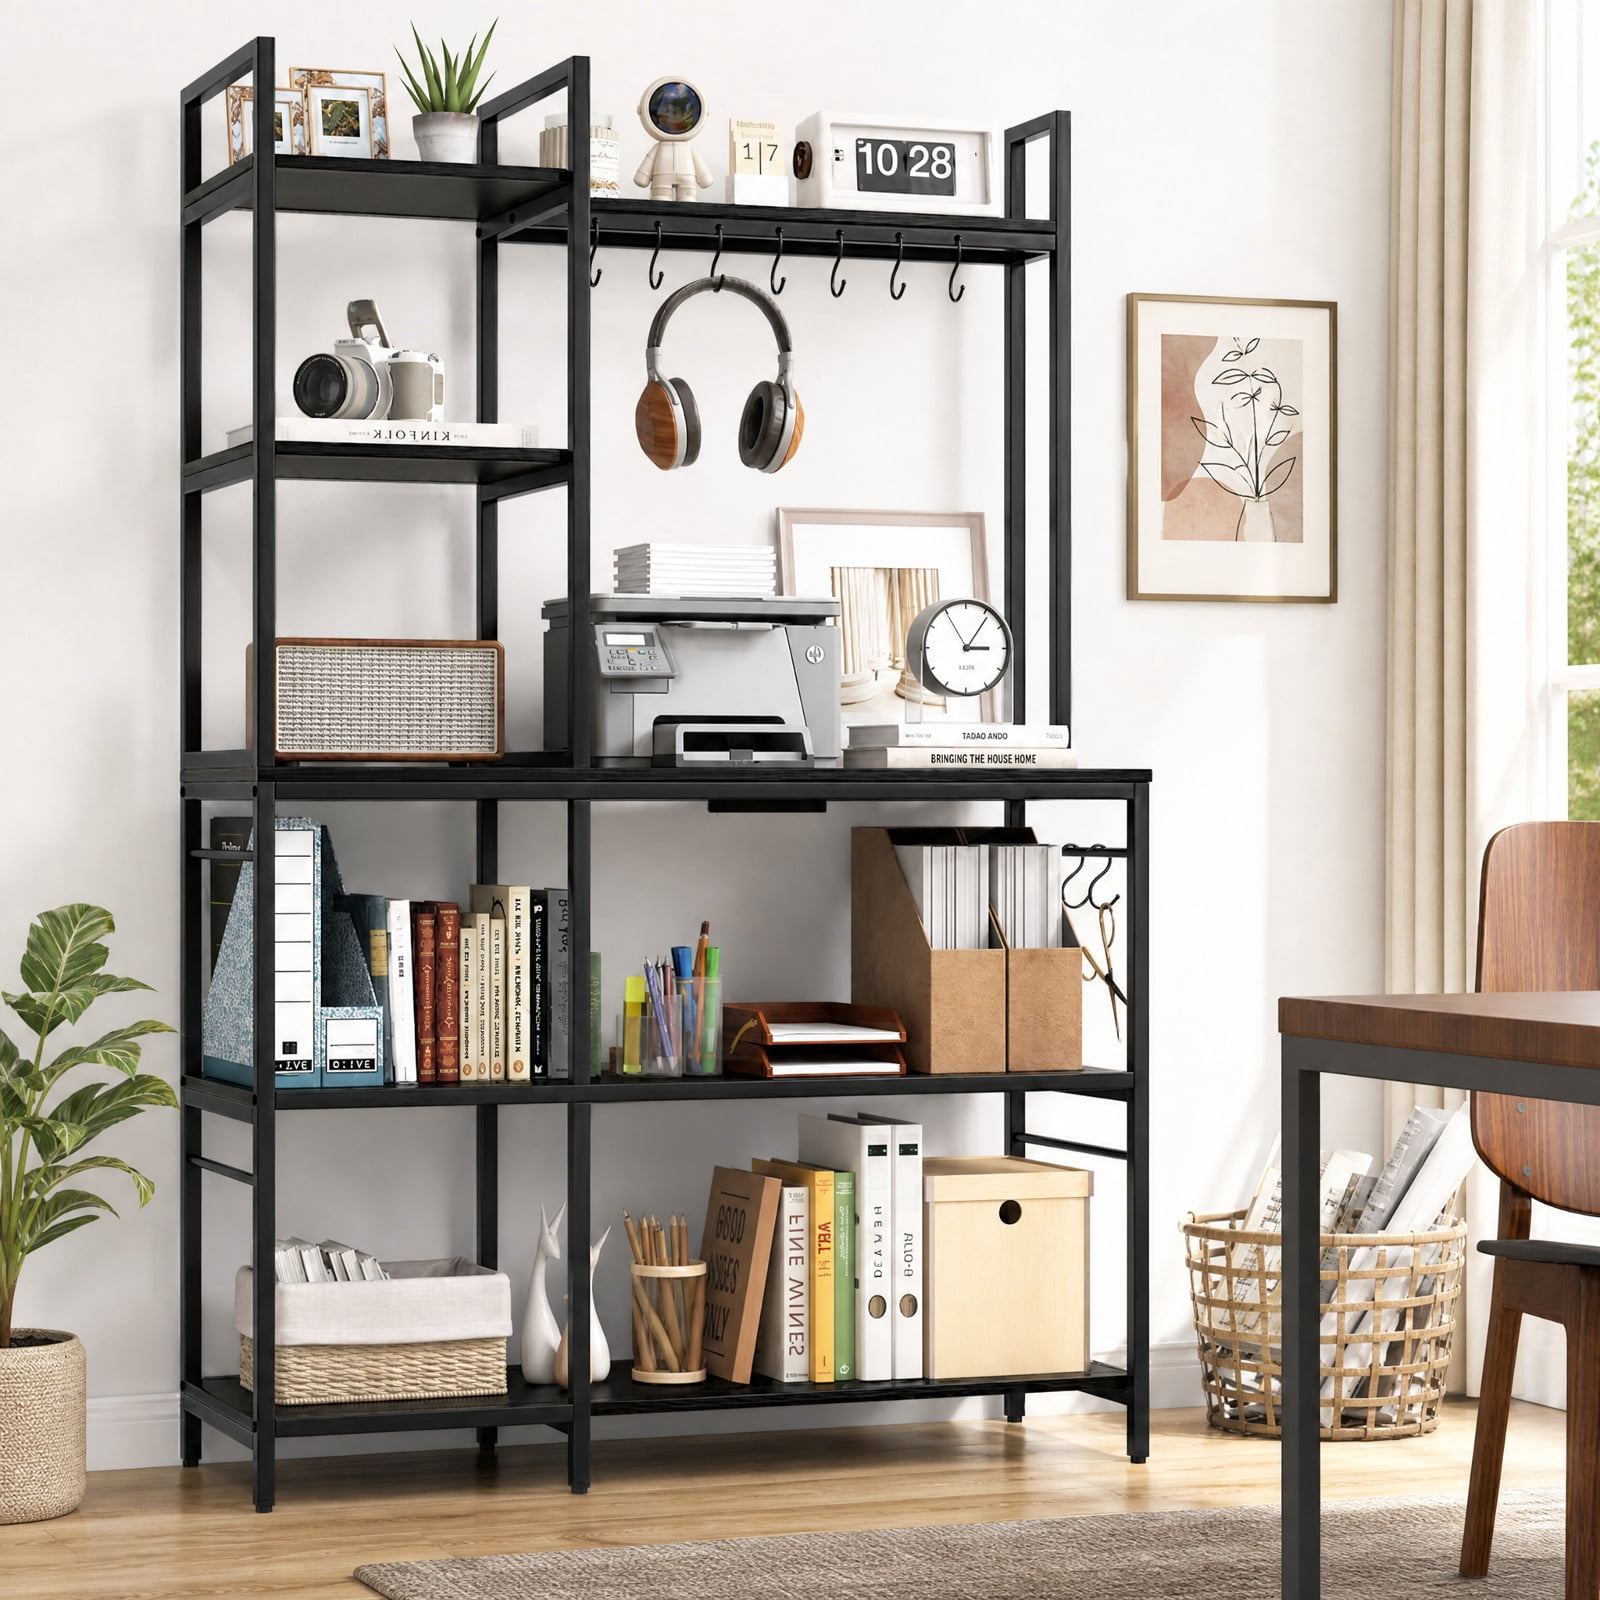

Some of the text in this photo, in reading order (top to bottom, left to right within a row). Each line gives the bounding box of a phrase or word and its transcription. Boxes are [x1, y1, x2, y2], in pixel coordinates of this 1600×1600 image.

[858, 142, 952, 180] 10 28
[962, 732, 1009, 740] TADAO ANDO
[931, 753, 1037, 764] BRINGING THE HOUSE HOME
